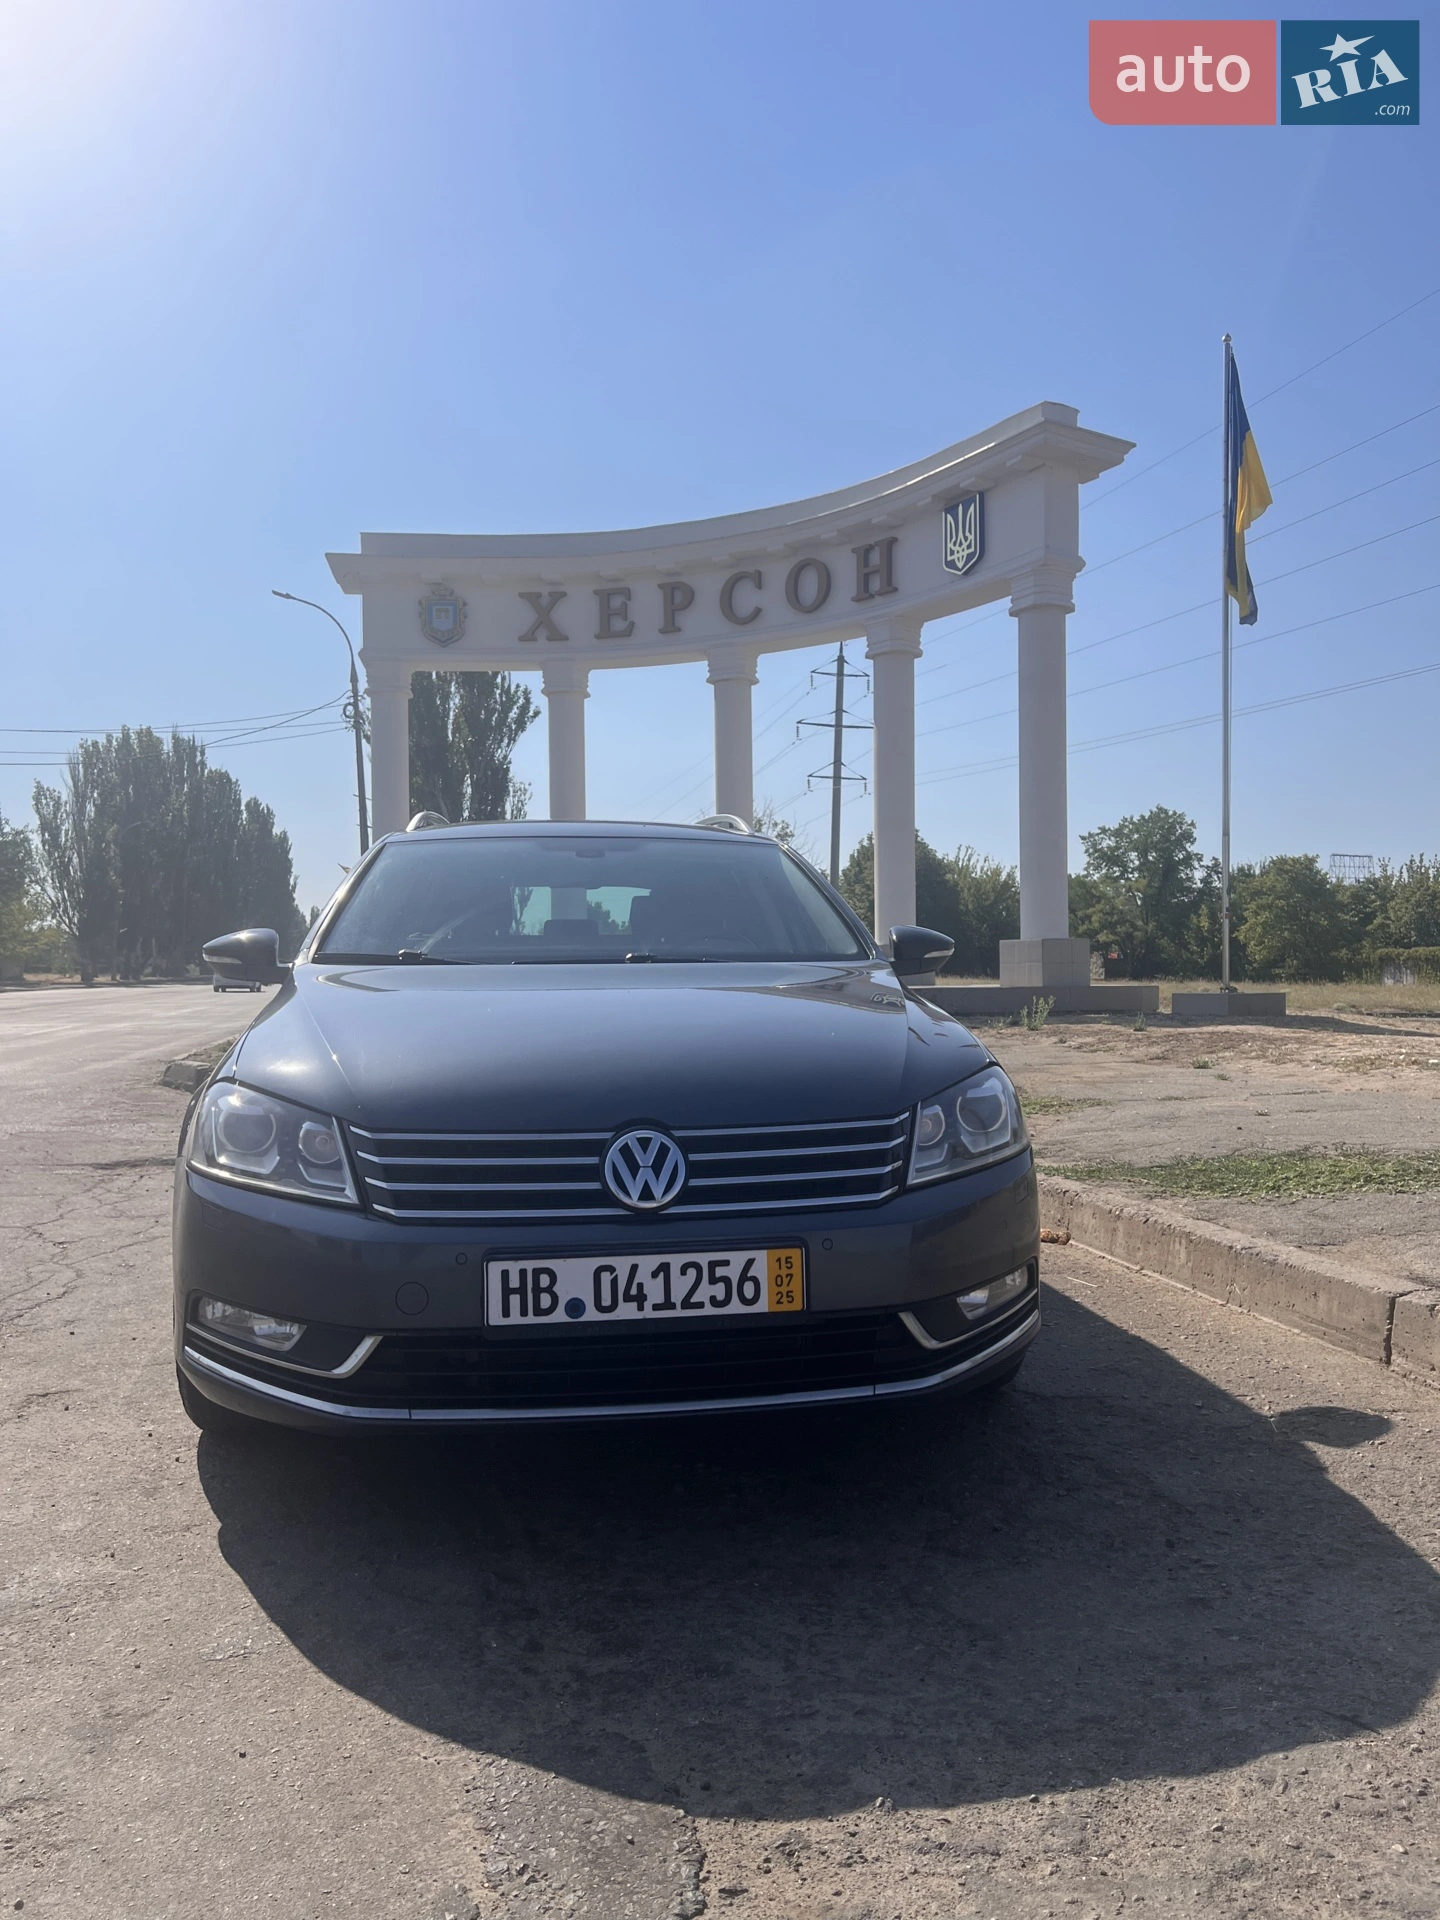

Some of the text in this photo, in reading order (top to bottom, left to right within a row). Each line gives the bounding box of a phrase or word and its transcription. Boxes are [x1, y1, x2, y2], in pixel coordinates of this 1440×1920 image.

[518, 536, 899, 642] ХЕРСОН
[775, 1256, 794, 1270] 15
[501, 1257, 761, 1318] HB 041256
[775, 1274, 794, 1288] 07
[775, 1291, 795, 1305] 25
